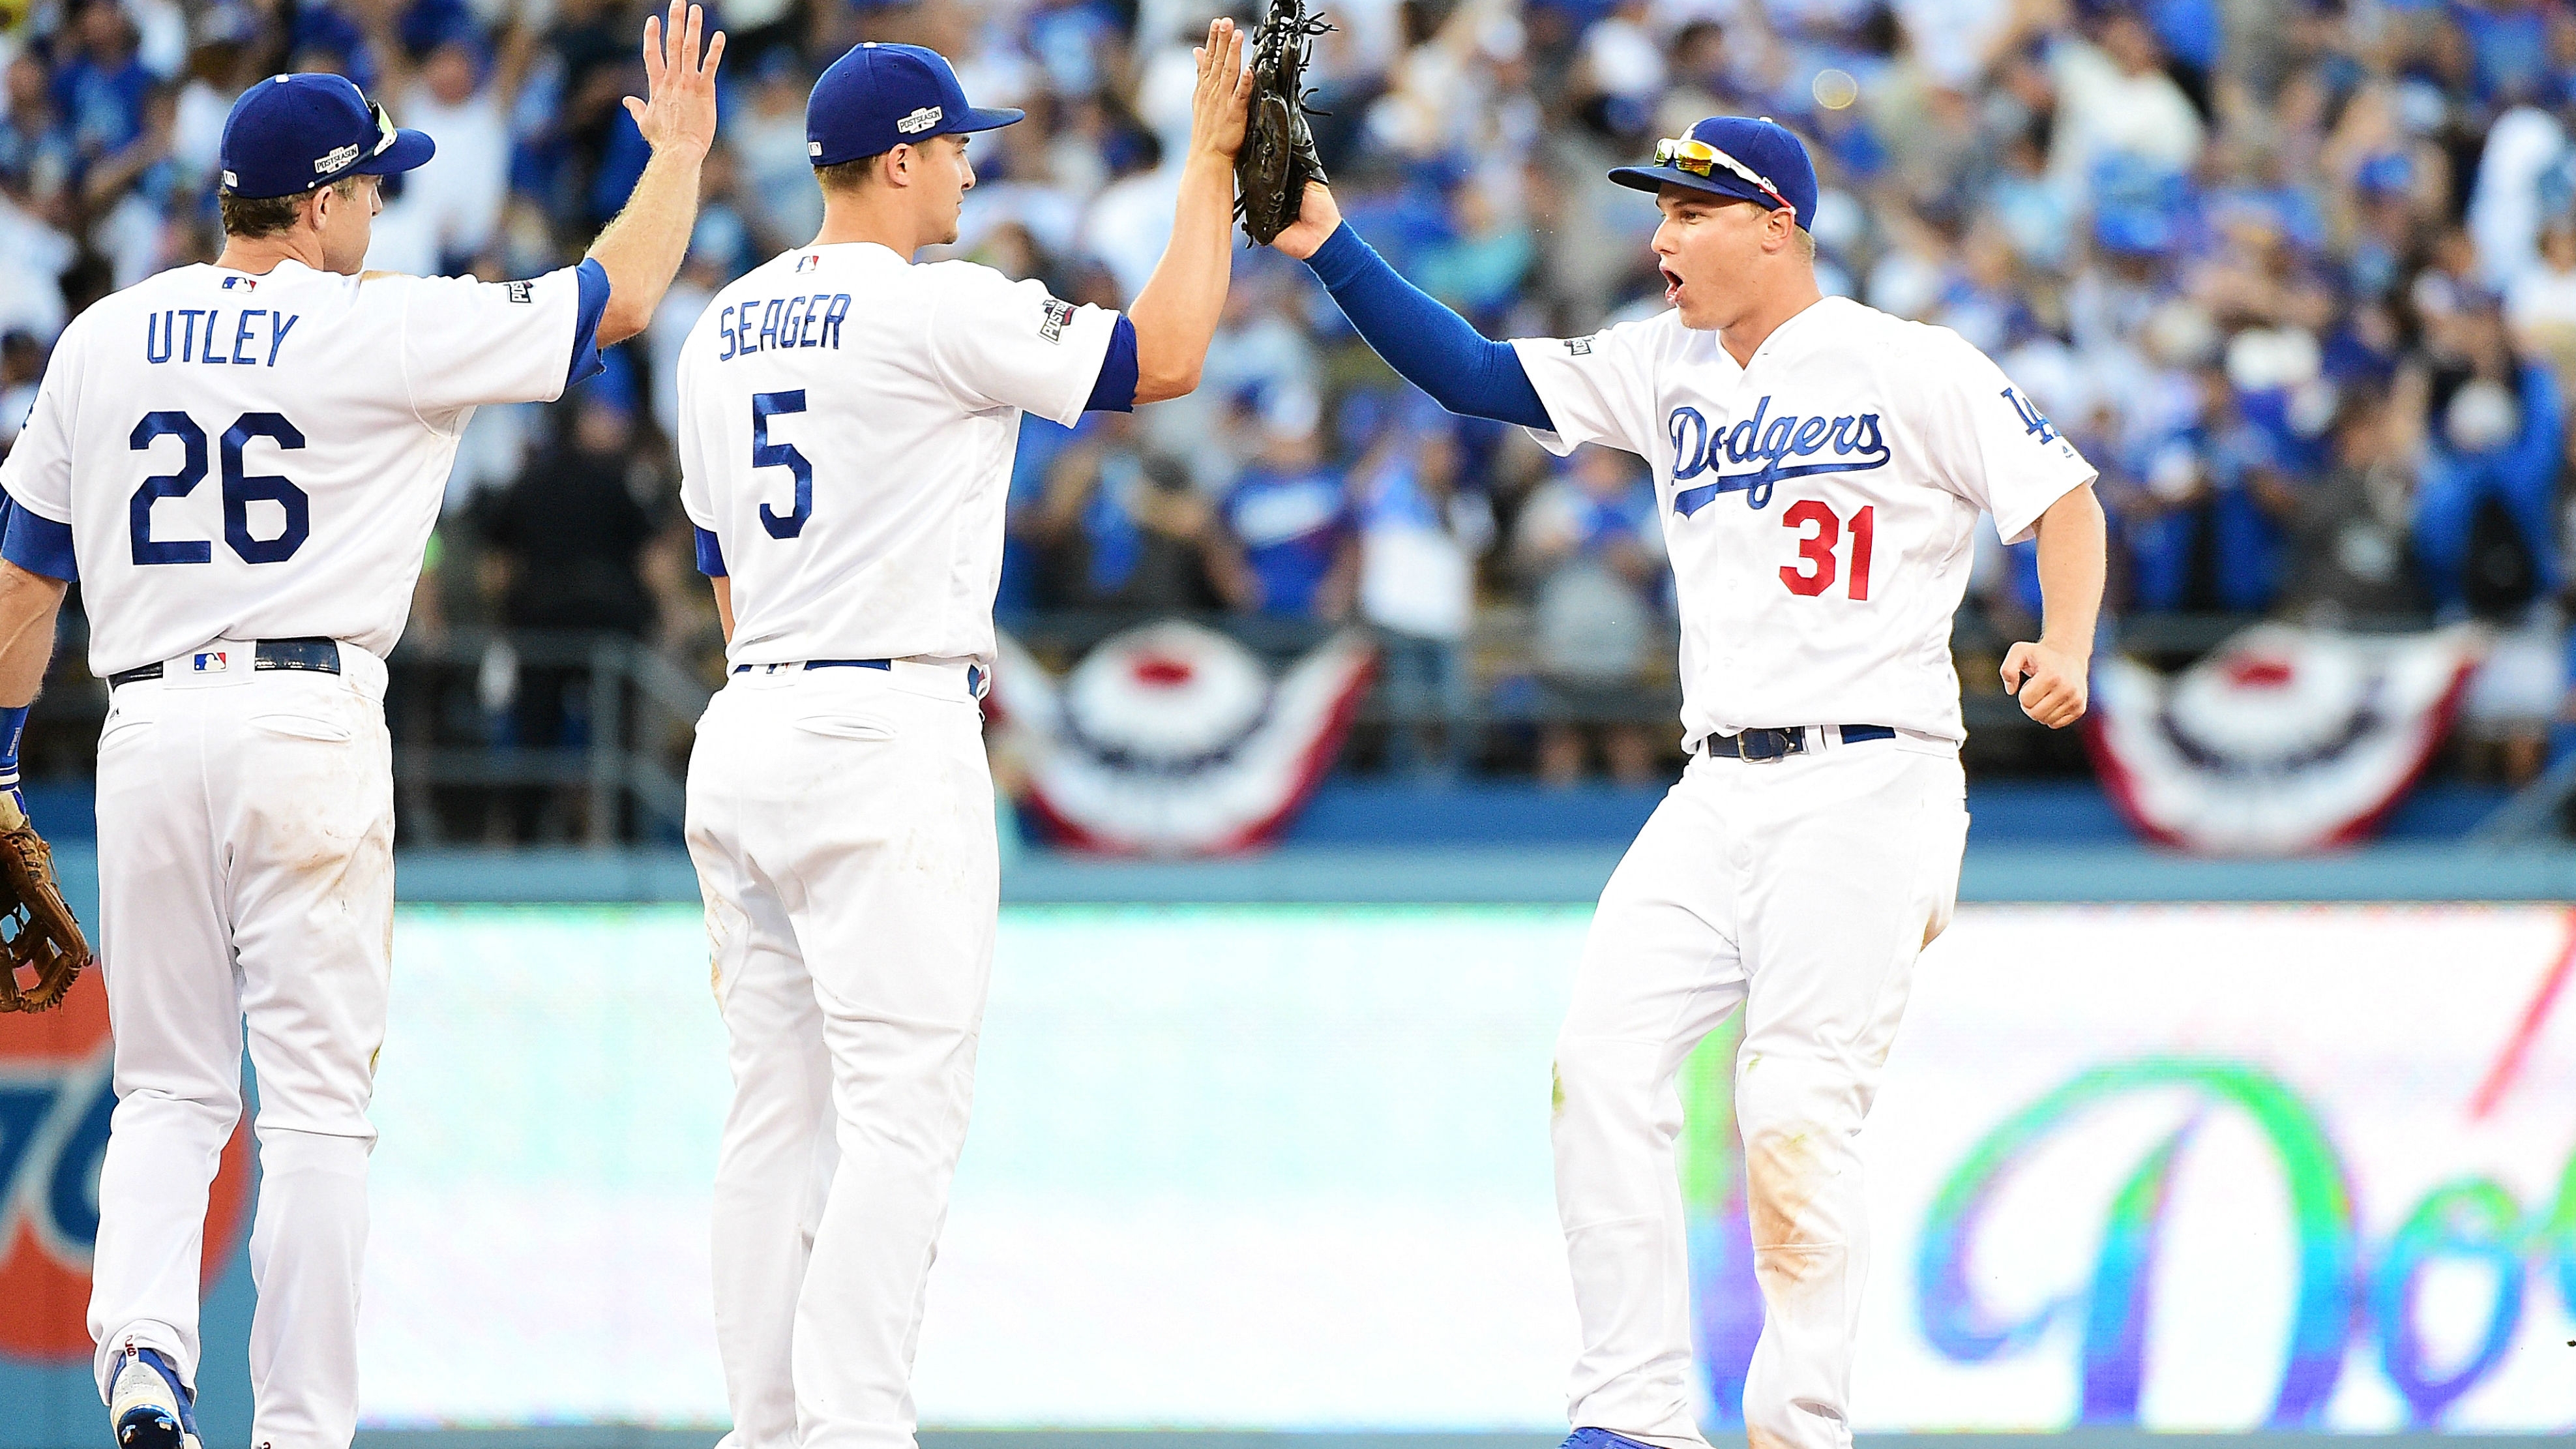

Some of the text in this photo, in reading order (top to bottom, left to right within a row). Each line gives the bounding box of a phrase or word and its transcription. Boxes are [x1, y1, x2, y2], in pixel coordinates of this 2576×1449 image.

[316, 147, 357, 171] POSTSEASON
[900, 110, 940, 130] POSTSEASON
[147, 309, 299, 367] UTLEY
[720, 293, 851, 362] SEAGER
[130, 411, 310, 565] 26
[752, 389, 812, 539] 5
[1669, 395, 1890, 516] Dodgers
[1779, 500, 1874, 601] 31
[1912, 1053, 2576, 1429] Do
